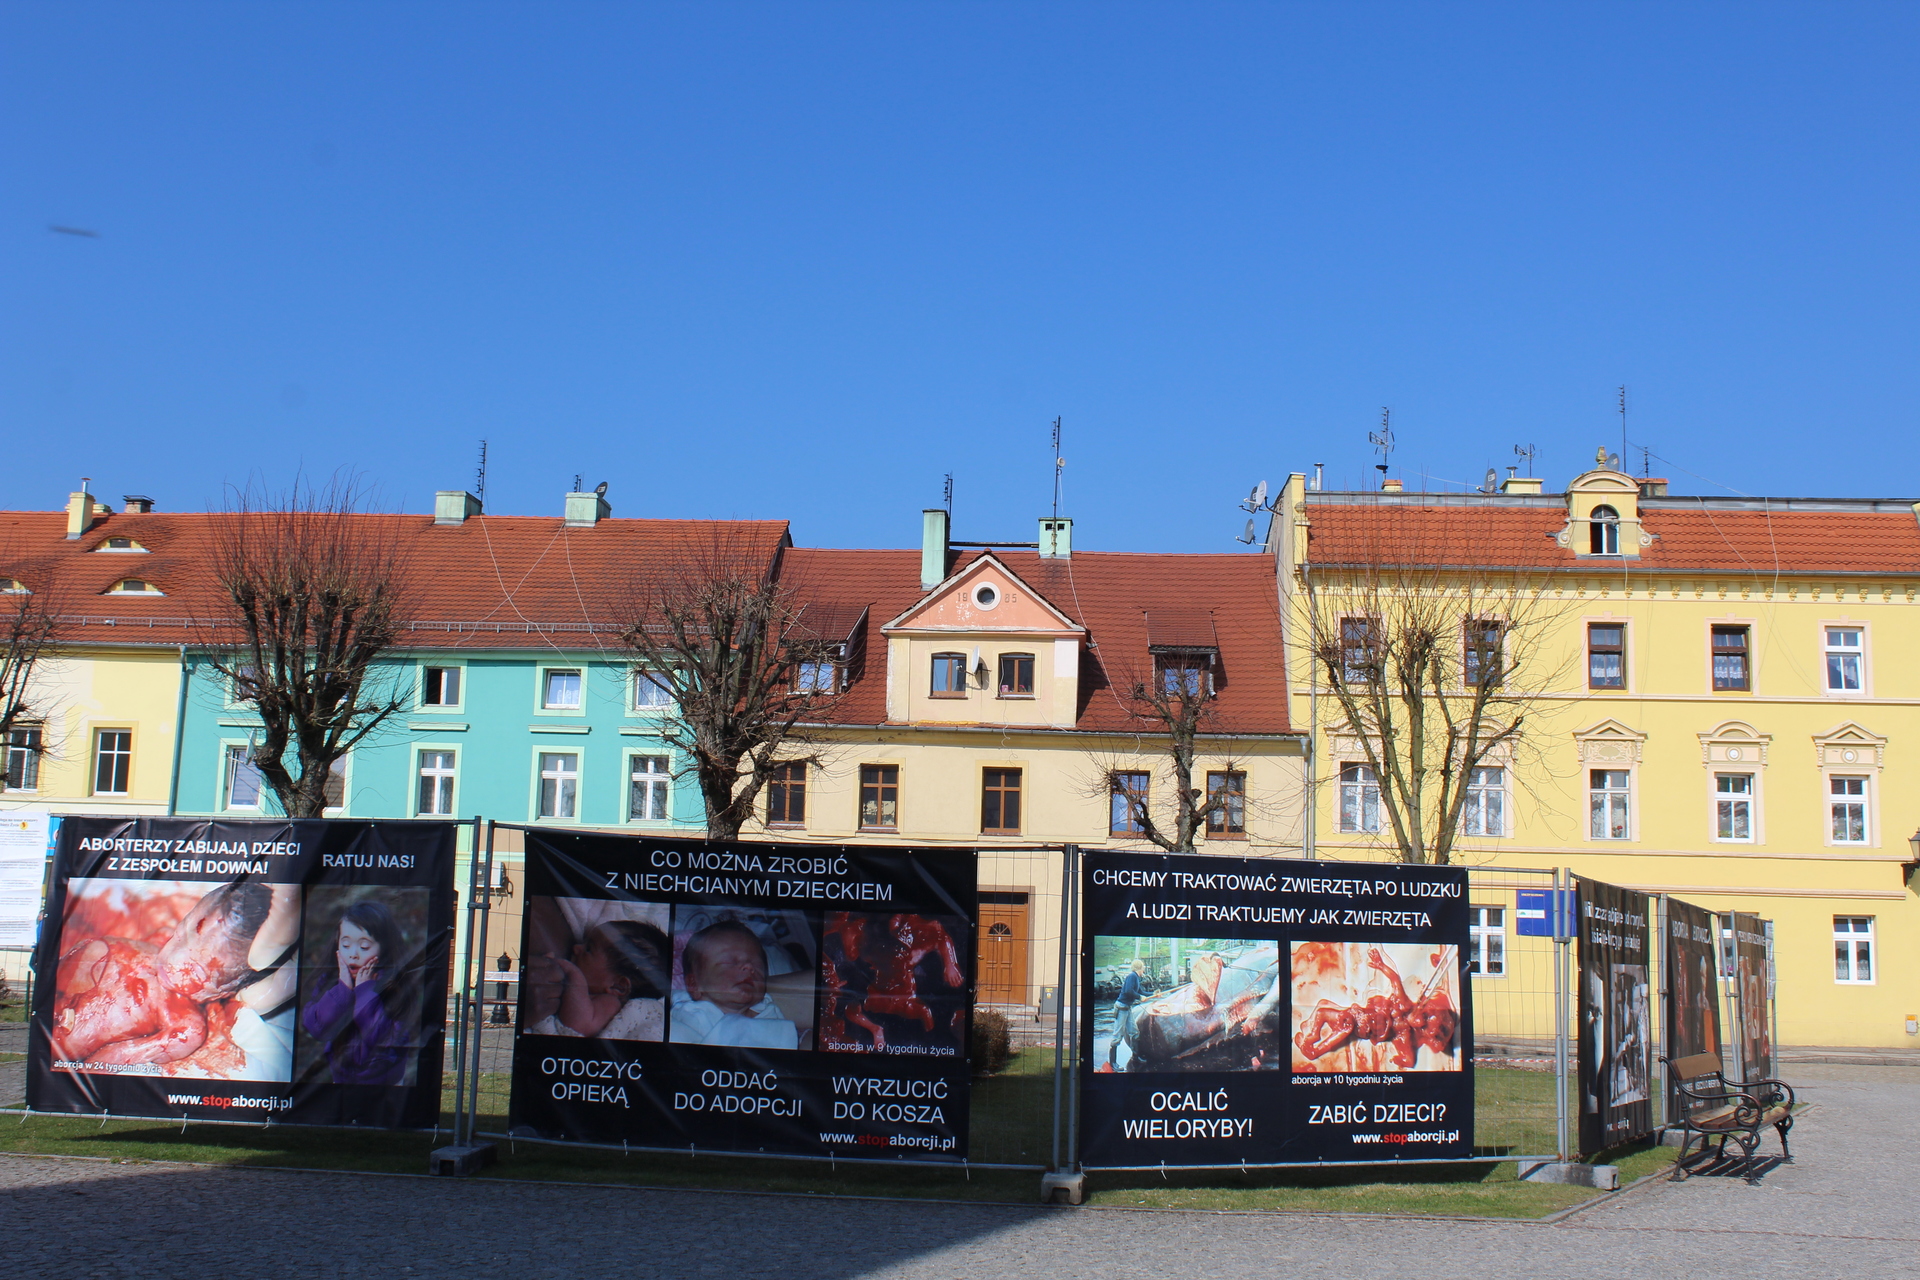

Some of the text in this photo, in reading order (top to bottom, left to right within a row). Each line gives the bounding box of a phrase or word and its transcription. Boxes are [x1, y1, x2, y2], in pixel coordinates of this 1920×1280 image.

[78, 837, 301, 858] ABORTERZY ZABIJAJĄ DZIECI
[107, 857, 269, 875] Z ZESPOŁEM DOWNA!
[322, 854, 415, 869] RATUJ NAS!
[650, 850, 848, 876] CO MOŻNA ZROBIĆ
[605, 872, 893, 901] Z NIECHCIANYM DZIECKIEM
[1093, 869, 1462, 899] CHCEMY TRAKTOWAĆ ZWIERZĘTA PO LUDZKU
[1126, 903, 1433, 930] A LUDZI TRAKTUJEMY JAK ZWIERZĘTA
[828, 1041, 955, 1057] aborcja w 9 tygodniu życia
[53, 1059, 84, 1071] aborcja
[85, 1062, 93, 1070] w
[94, 1061, 105, 1070] 24
[541, 1057, 643, 1080] OTOCZYĆ
[701, 1069, 778, 1091] ODDAĆ
[832, 1076, 948, 1100] WYRZUCIĆ
[1291, 1074, 1404, 1086] aborcja w 10 tygodniu życia
[168, 1093, 293, 1110] www.stopaborcji.pl
[551, 1082, 630, 1108] OPIEKĄ
[674, 1092, 802, 1118] DO ADOPCJI
[1150, 1088, 1229, 1112] OCALIĆ
[833, 1101, 945, 1125] DO KOSZA
[1308, 1101, 1447, 1124] ZABIĆ DZIECI?
[1123, 1118, 1253, 1139] WIELORYBY!
[1352, 1130, 1460, 1145] www.stopaborcji.pl
[819, 1130, 956, 1151] www.stopaborcji.pl
